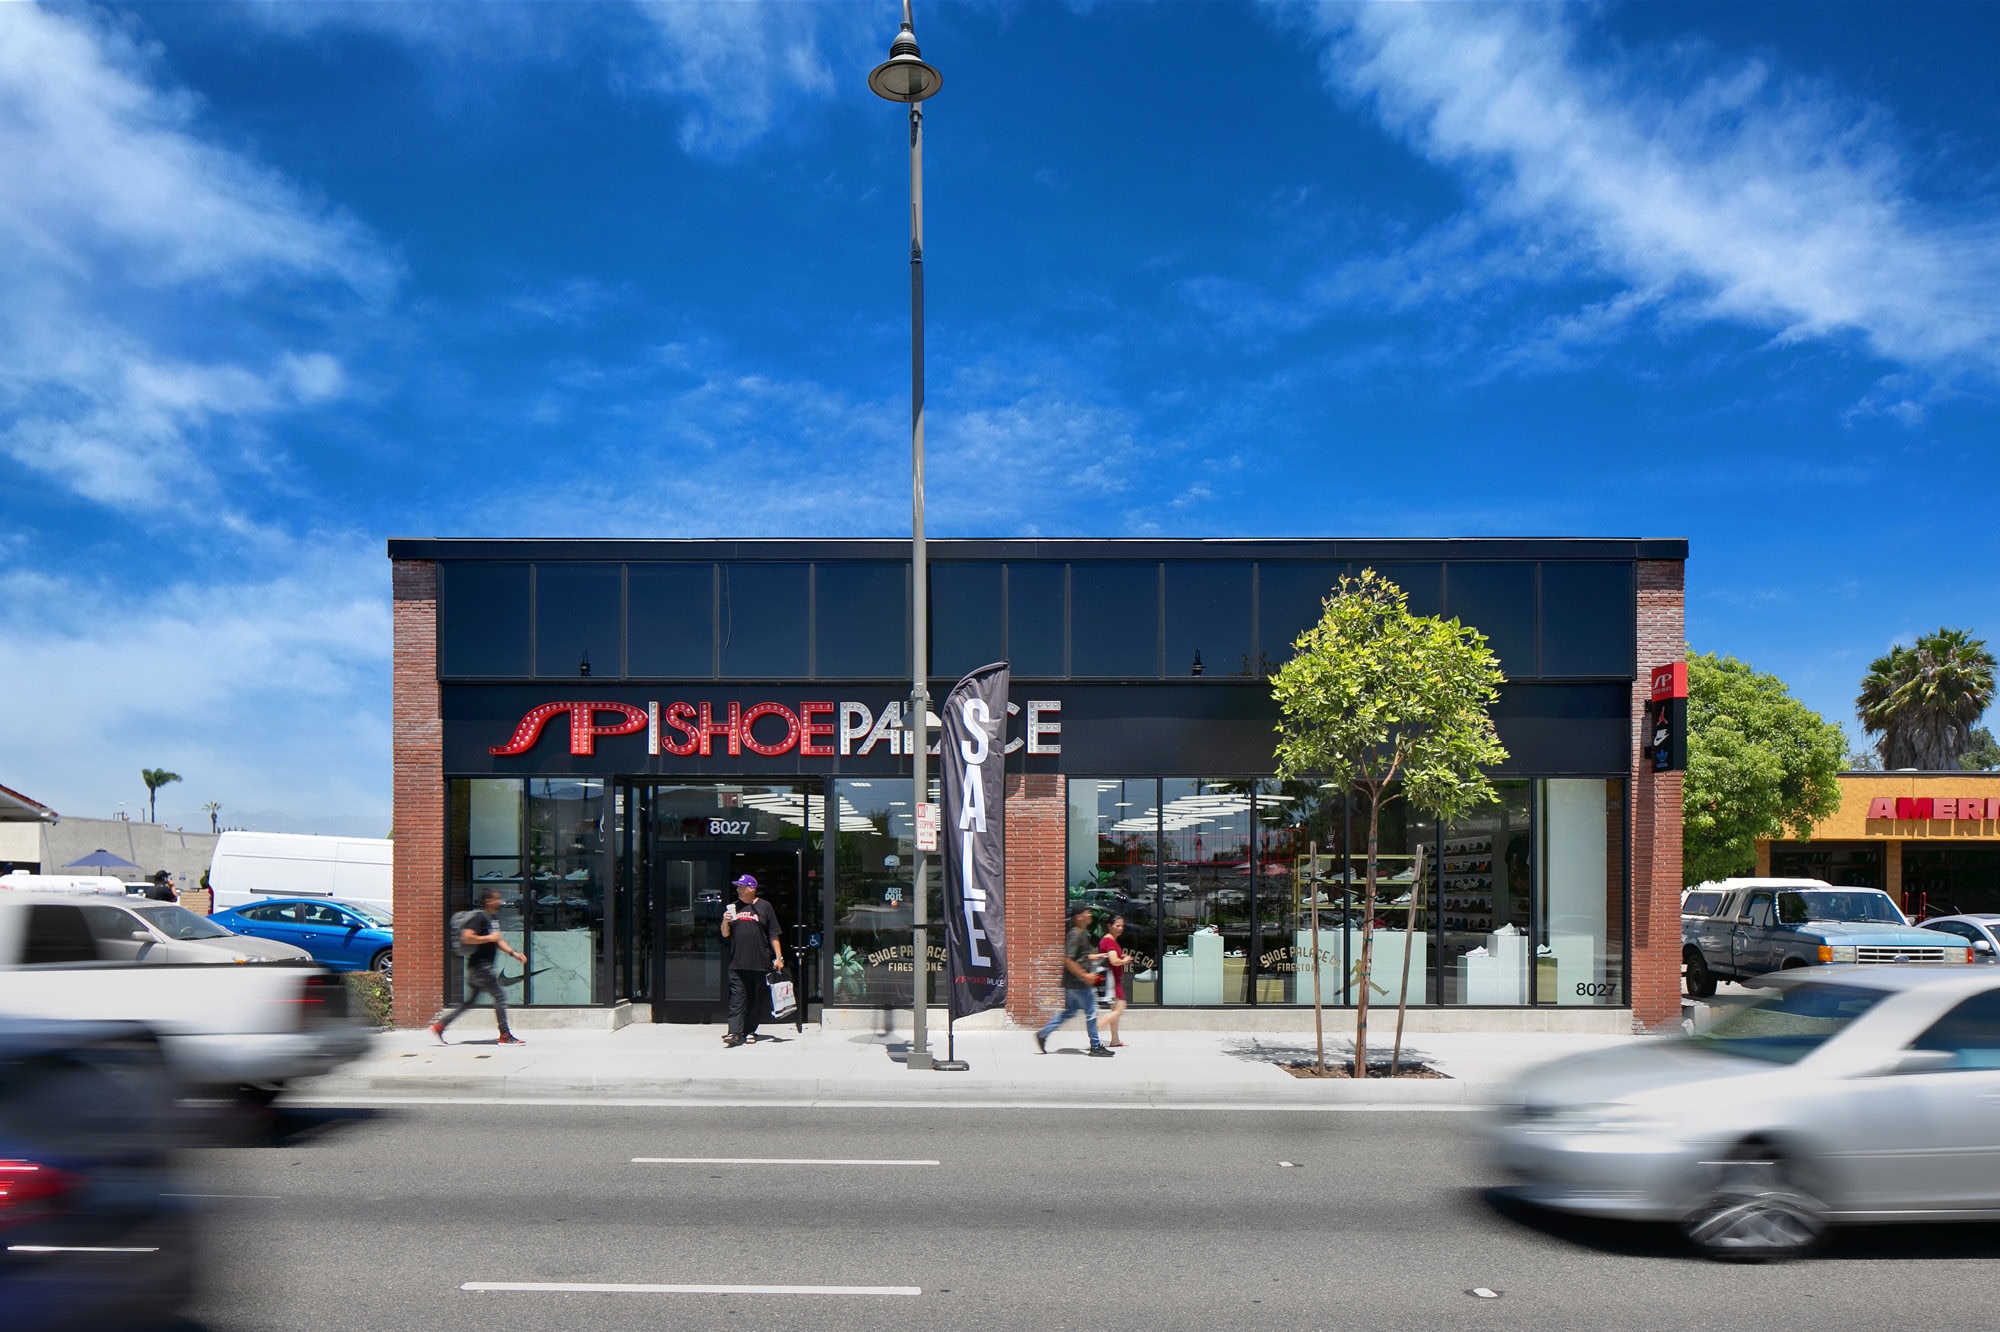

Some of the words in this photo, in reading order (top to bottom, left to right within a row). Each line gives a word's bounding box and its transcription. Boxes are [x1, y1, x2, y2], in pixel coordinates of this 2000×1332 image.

[710, 821, 750, 834] 8027
[959, 698, 992, 967] SALE
[868, 946, 898, 967] SHOE
[900, 945, 947, 962] PAACE
[1260, 947, 1288, 968] SHOE
[888, 963, 943, 972] FIRESONE
[1277, 963, 1322, 972] FIRESTOE
[1576, 982, 1617, 997] 8027
